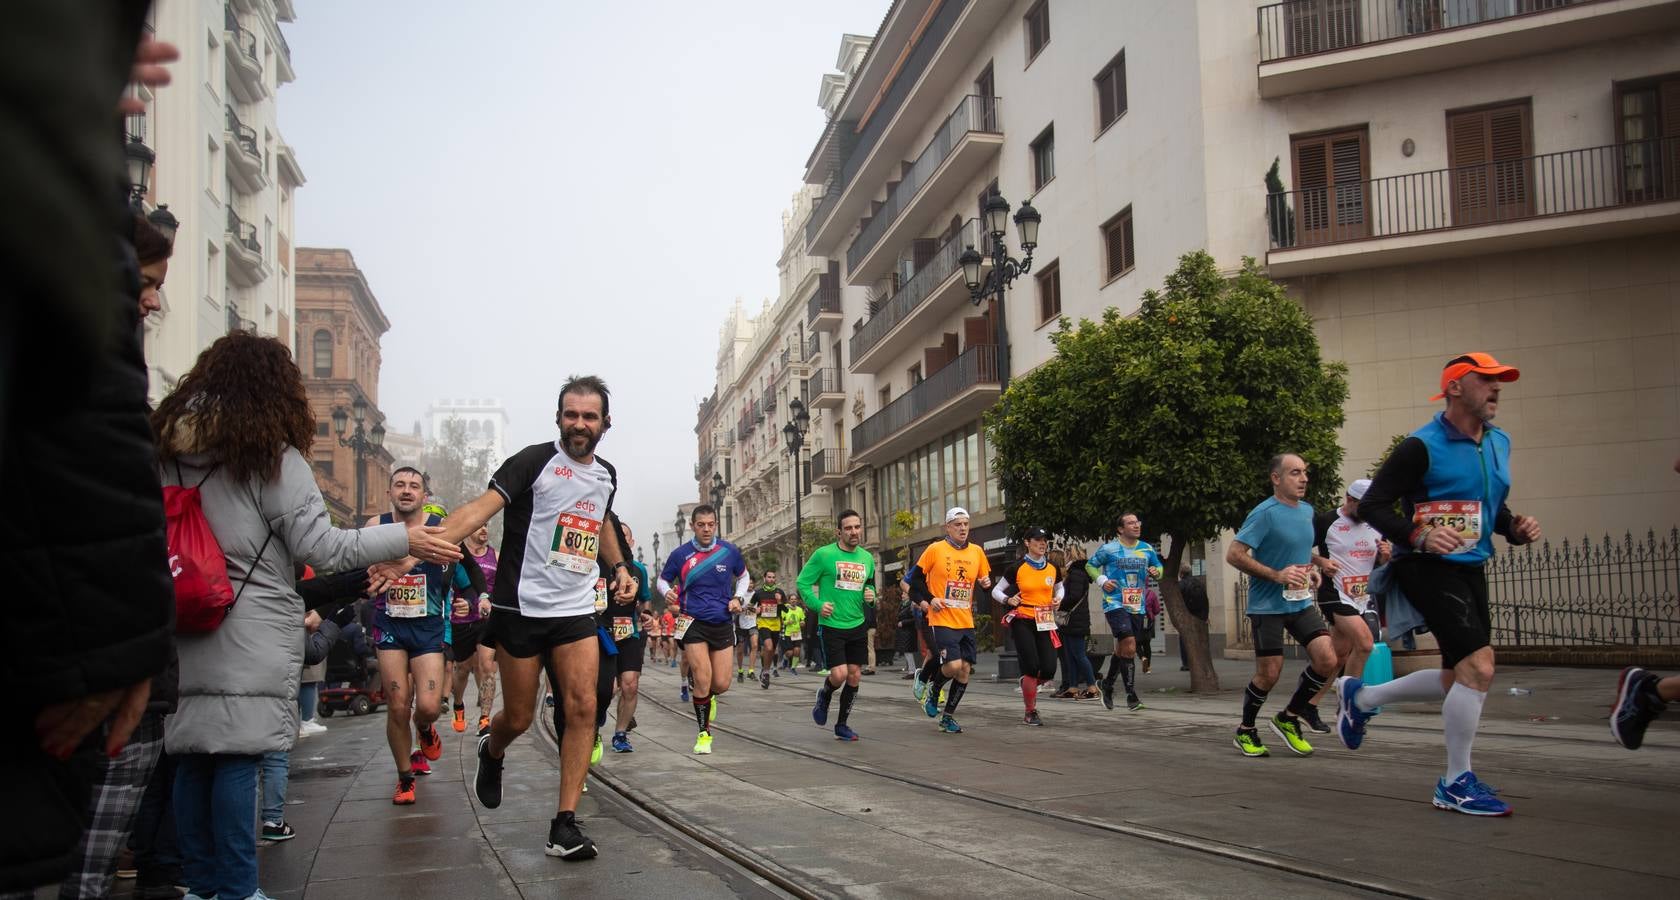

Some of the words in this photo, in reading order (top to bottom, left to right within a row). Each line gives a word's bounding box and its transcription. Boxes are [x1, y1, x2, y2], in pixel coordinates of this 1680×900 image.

[555, 466, 573, 479] edp
[575, 499, 596, 512] edp
[1439, 503, 1452, 512] edp
[1462, 503, 1476, 512] edp
[561, 515, 574, 524] edp
[578, 520, 590, 529] edp
[565, 531, 596, 552] 8012
[390, 588, 417, 600] 2052
